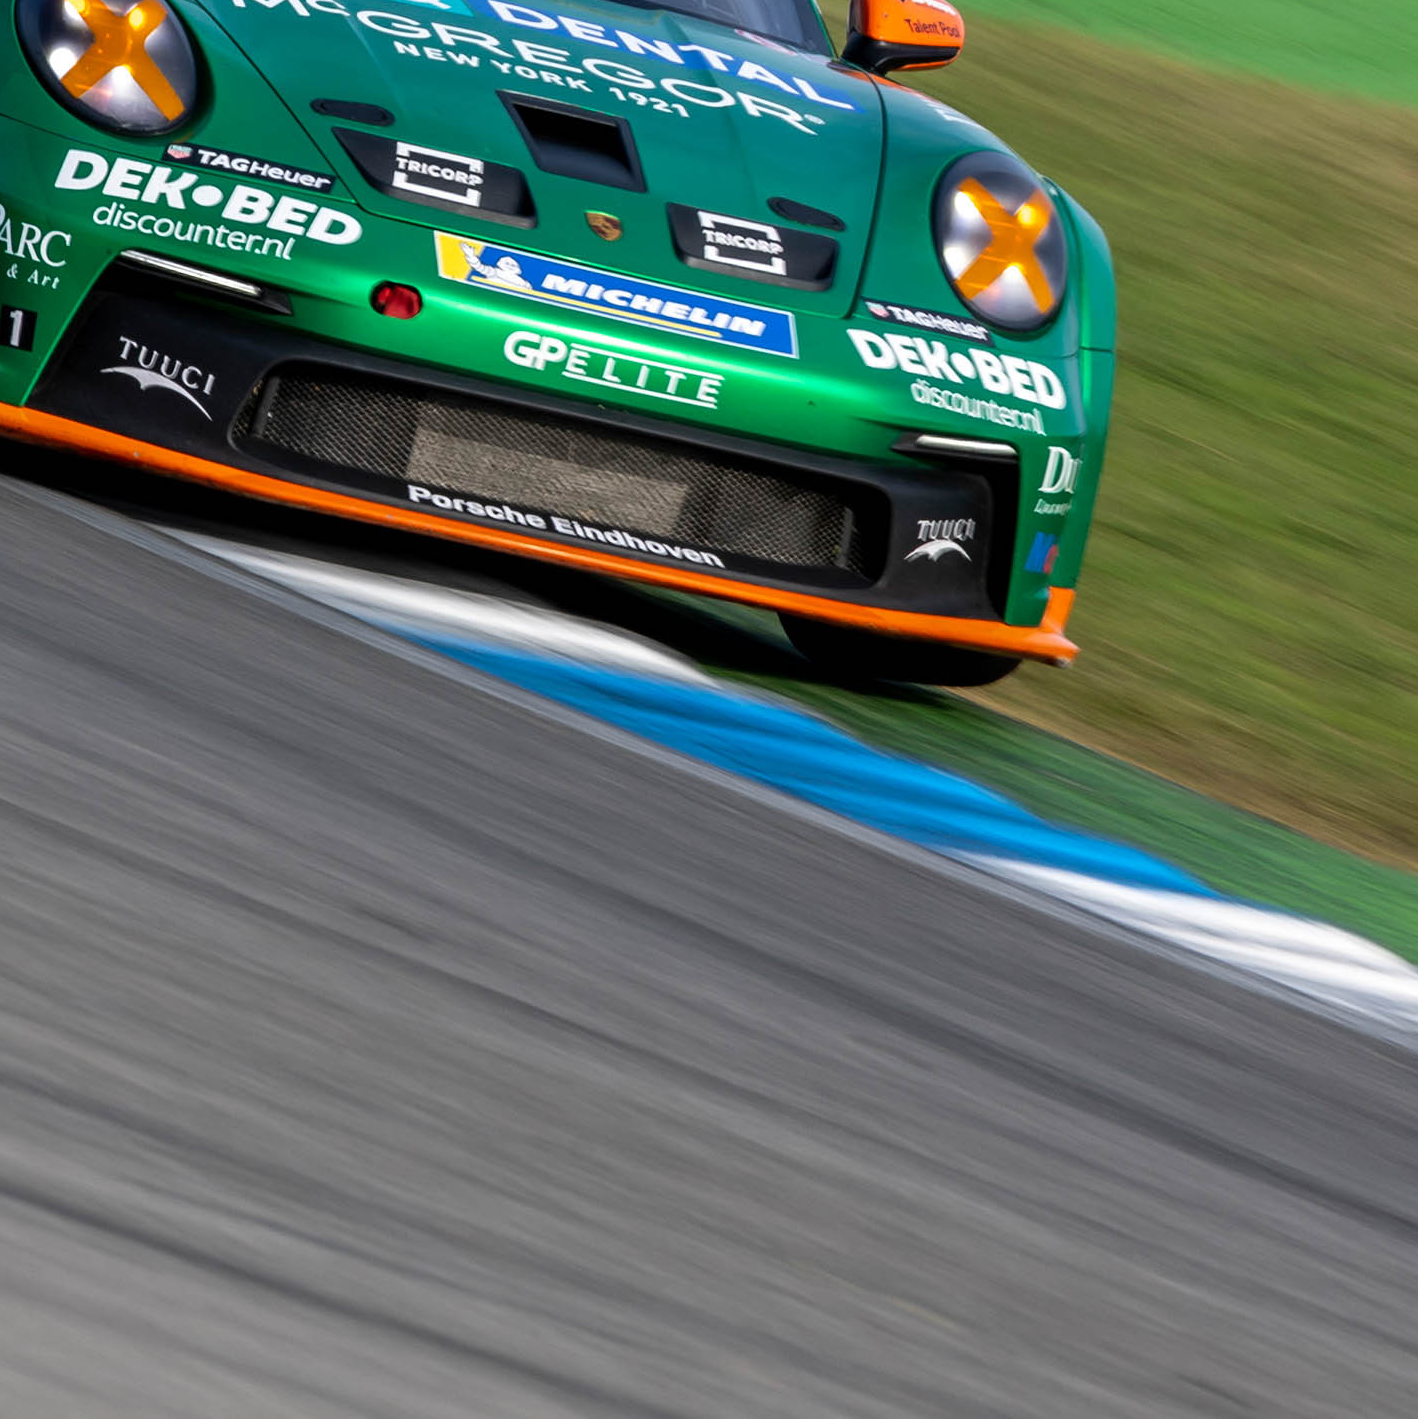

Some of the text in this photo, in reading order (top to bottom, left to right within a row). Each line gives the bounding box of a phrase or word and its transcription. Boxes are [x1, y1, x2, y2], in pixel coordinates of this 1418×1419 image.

[487, 0, 854, 110] DENTAL
[904, 18, 940, 36] Talent
[394, 41, 690, 117] NEW YORK 1921
[396, 156, 484, 187] TRICORP
[92, 201, 295, 260] discounter.nl
[702, 229, 784, 254] TRICORP
[7, 263, 18, 279] &
[27, 269, 60, 289] Art
[541, 273, 766, 337] MICHELIN
[9, 309, 24, 347] 1
[119, 335, 216, 395] TUUCI
[407, 485, 725, 568] Porsche Eindhoven
